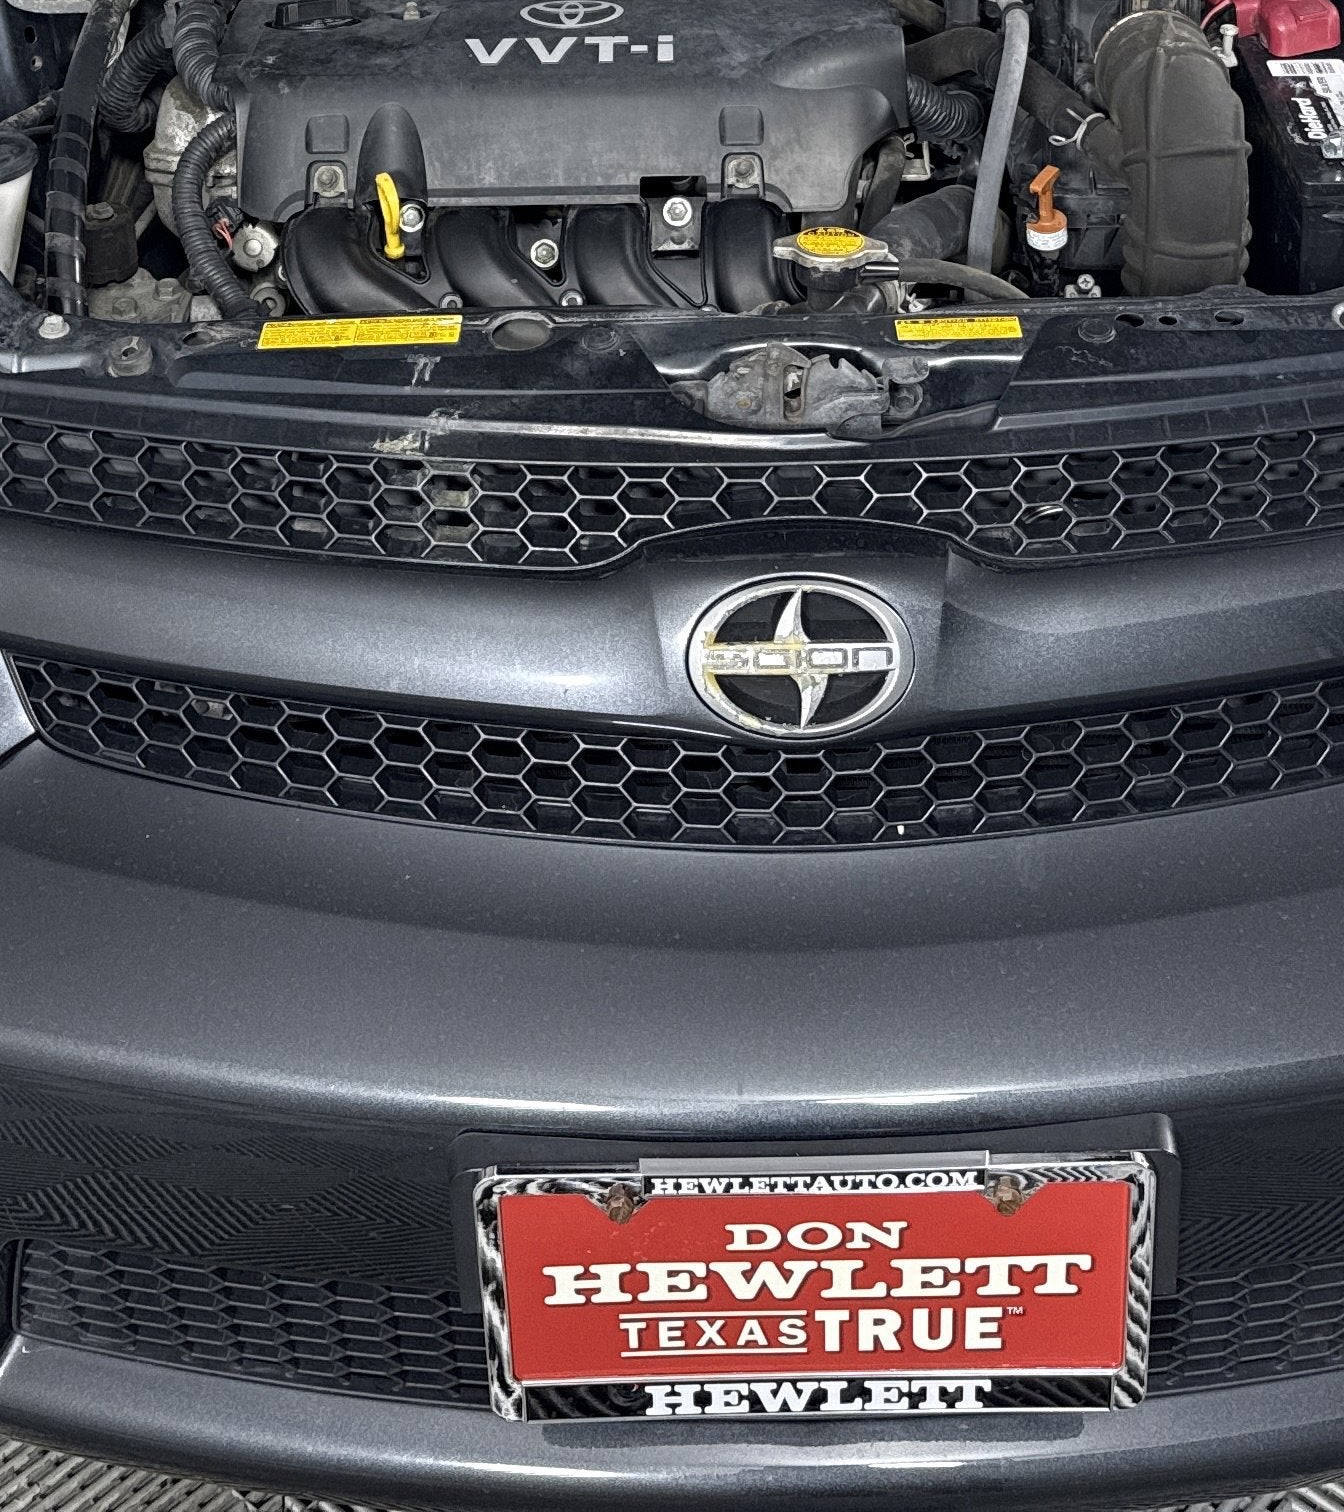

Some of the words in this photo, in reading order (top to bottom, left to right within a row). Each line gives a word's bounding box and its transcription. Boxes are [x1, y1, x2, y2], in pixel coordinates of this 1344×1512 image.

[464, 34, 675, 66] VVT-i
[1290, 97, 1328, 140] DieHard
[650, 1170, 980, 1194] HEWLETTAUTO.COM
[725, 1219, 908, 1252] DON
[541, 1253, 1093, 1306] HEWLETT
[621, 1317, 808, 1352] TEXAS
[645, 1379, 992, 1416] HEWLETT
